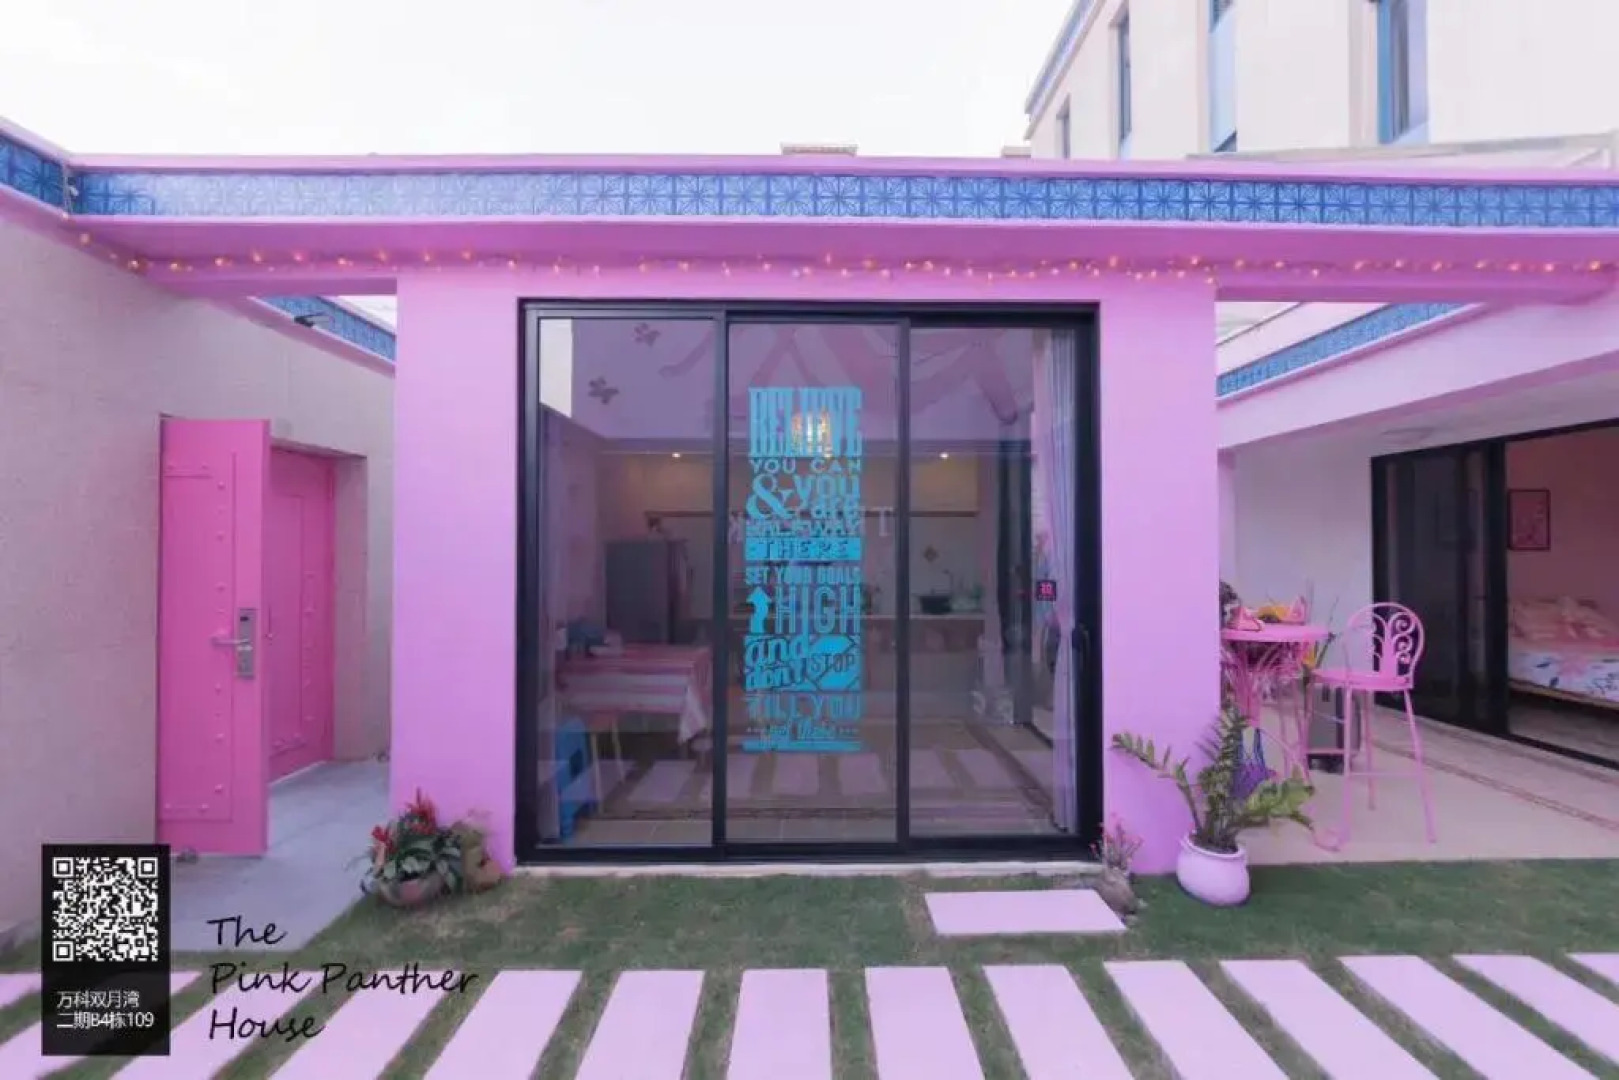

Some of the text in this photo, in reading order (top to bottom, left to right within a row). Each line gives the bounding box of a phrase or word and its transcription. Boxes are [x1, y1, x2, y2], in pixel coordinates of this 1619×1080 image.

[749, 459, 861, 474] YOU CAN
[764, 540, 850, 560] THERE
[746, 566, 769, 585] SET
[774, 584, 861, 635] HIGH
